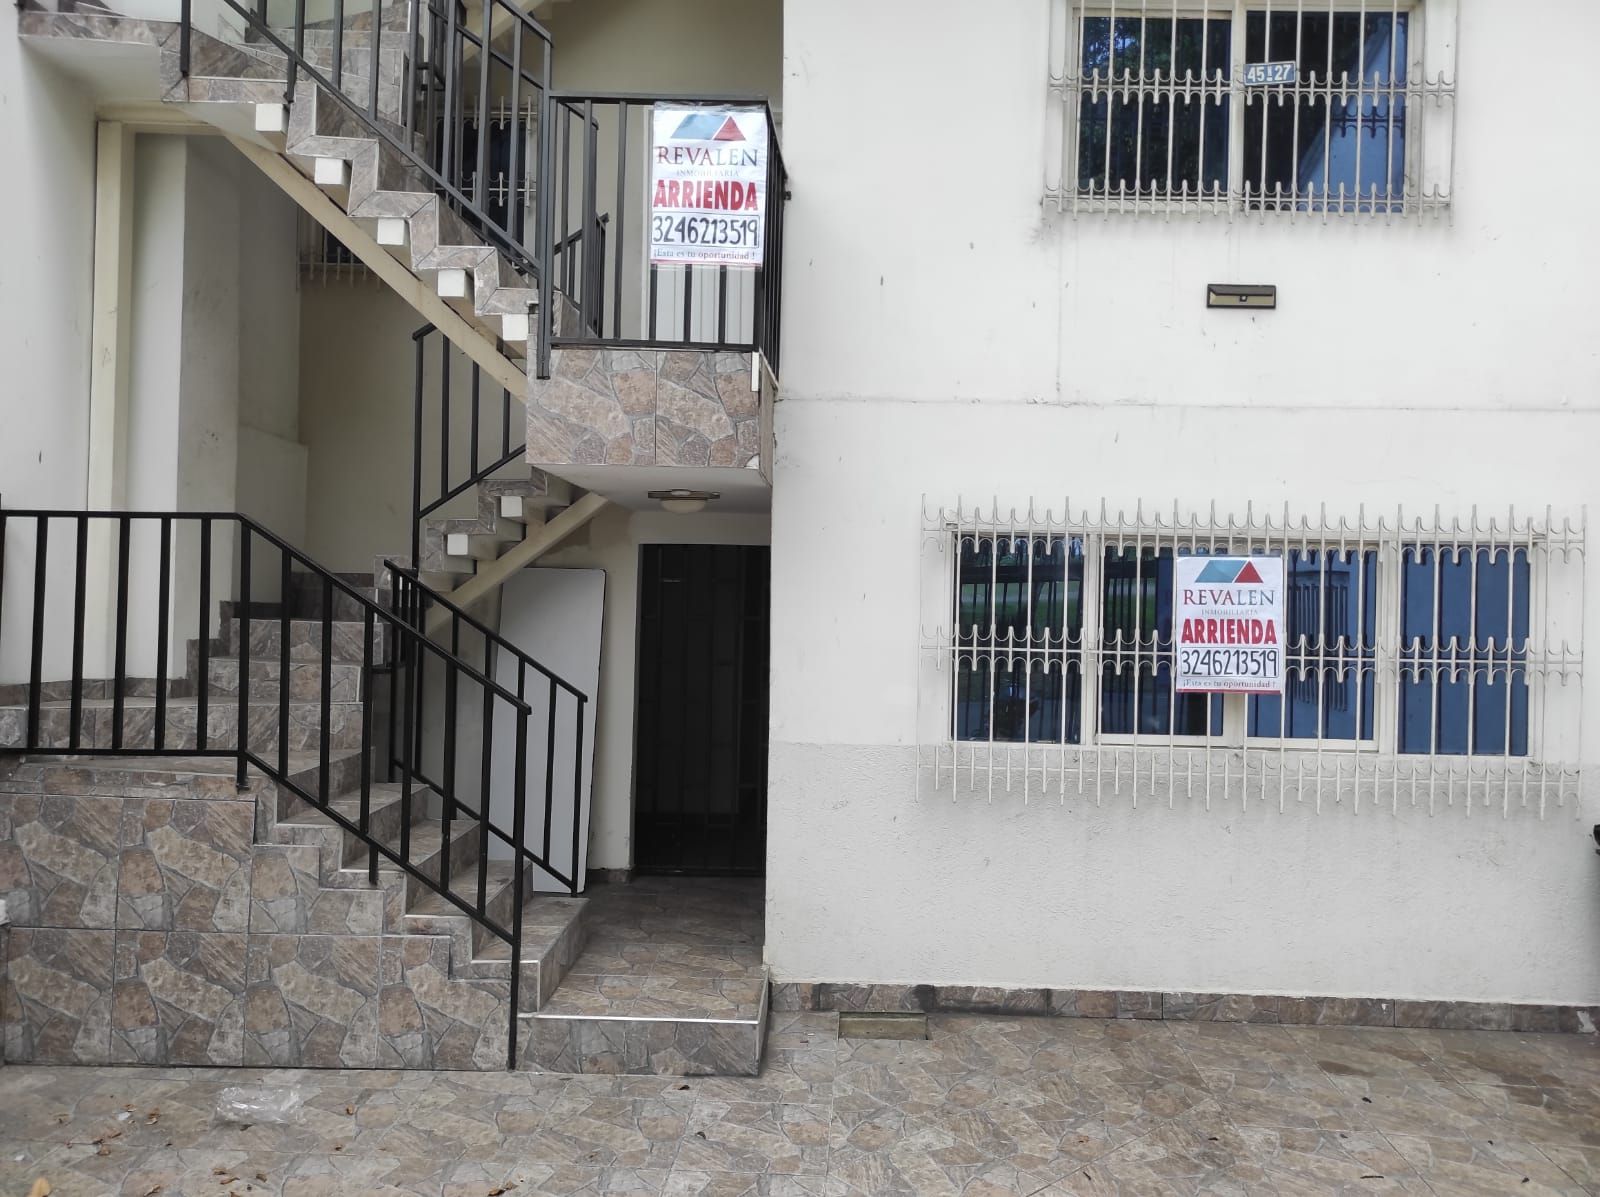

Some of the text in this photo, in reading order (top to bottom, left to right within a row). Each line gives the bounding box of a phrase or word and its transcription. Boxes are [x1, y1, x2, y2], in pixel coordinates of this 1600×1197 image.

[657, 146, 758, 166] REVALEN
[653, 179, 758, 211] ARRIENDA
[653, 215, 758, 246] 3246213519
[676, 250, 686, 258] es
[687, 249, 698, 258] tu
[699, 249, 749, 261] oportunidad
[1183, 589, 1275, 606] REVALEN
[1181, 618, 1277, 645] ARRIENDA
[1181, 649, 1277, 677] 3246213519
[1223, 680, 1271, 689] oportunidad
